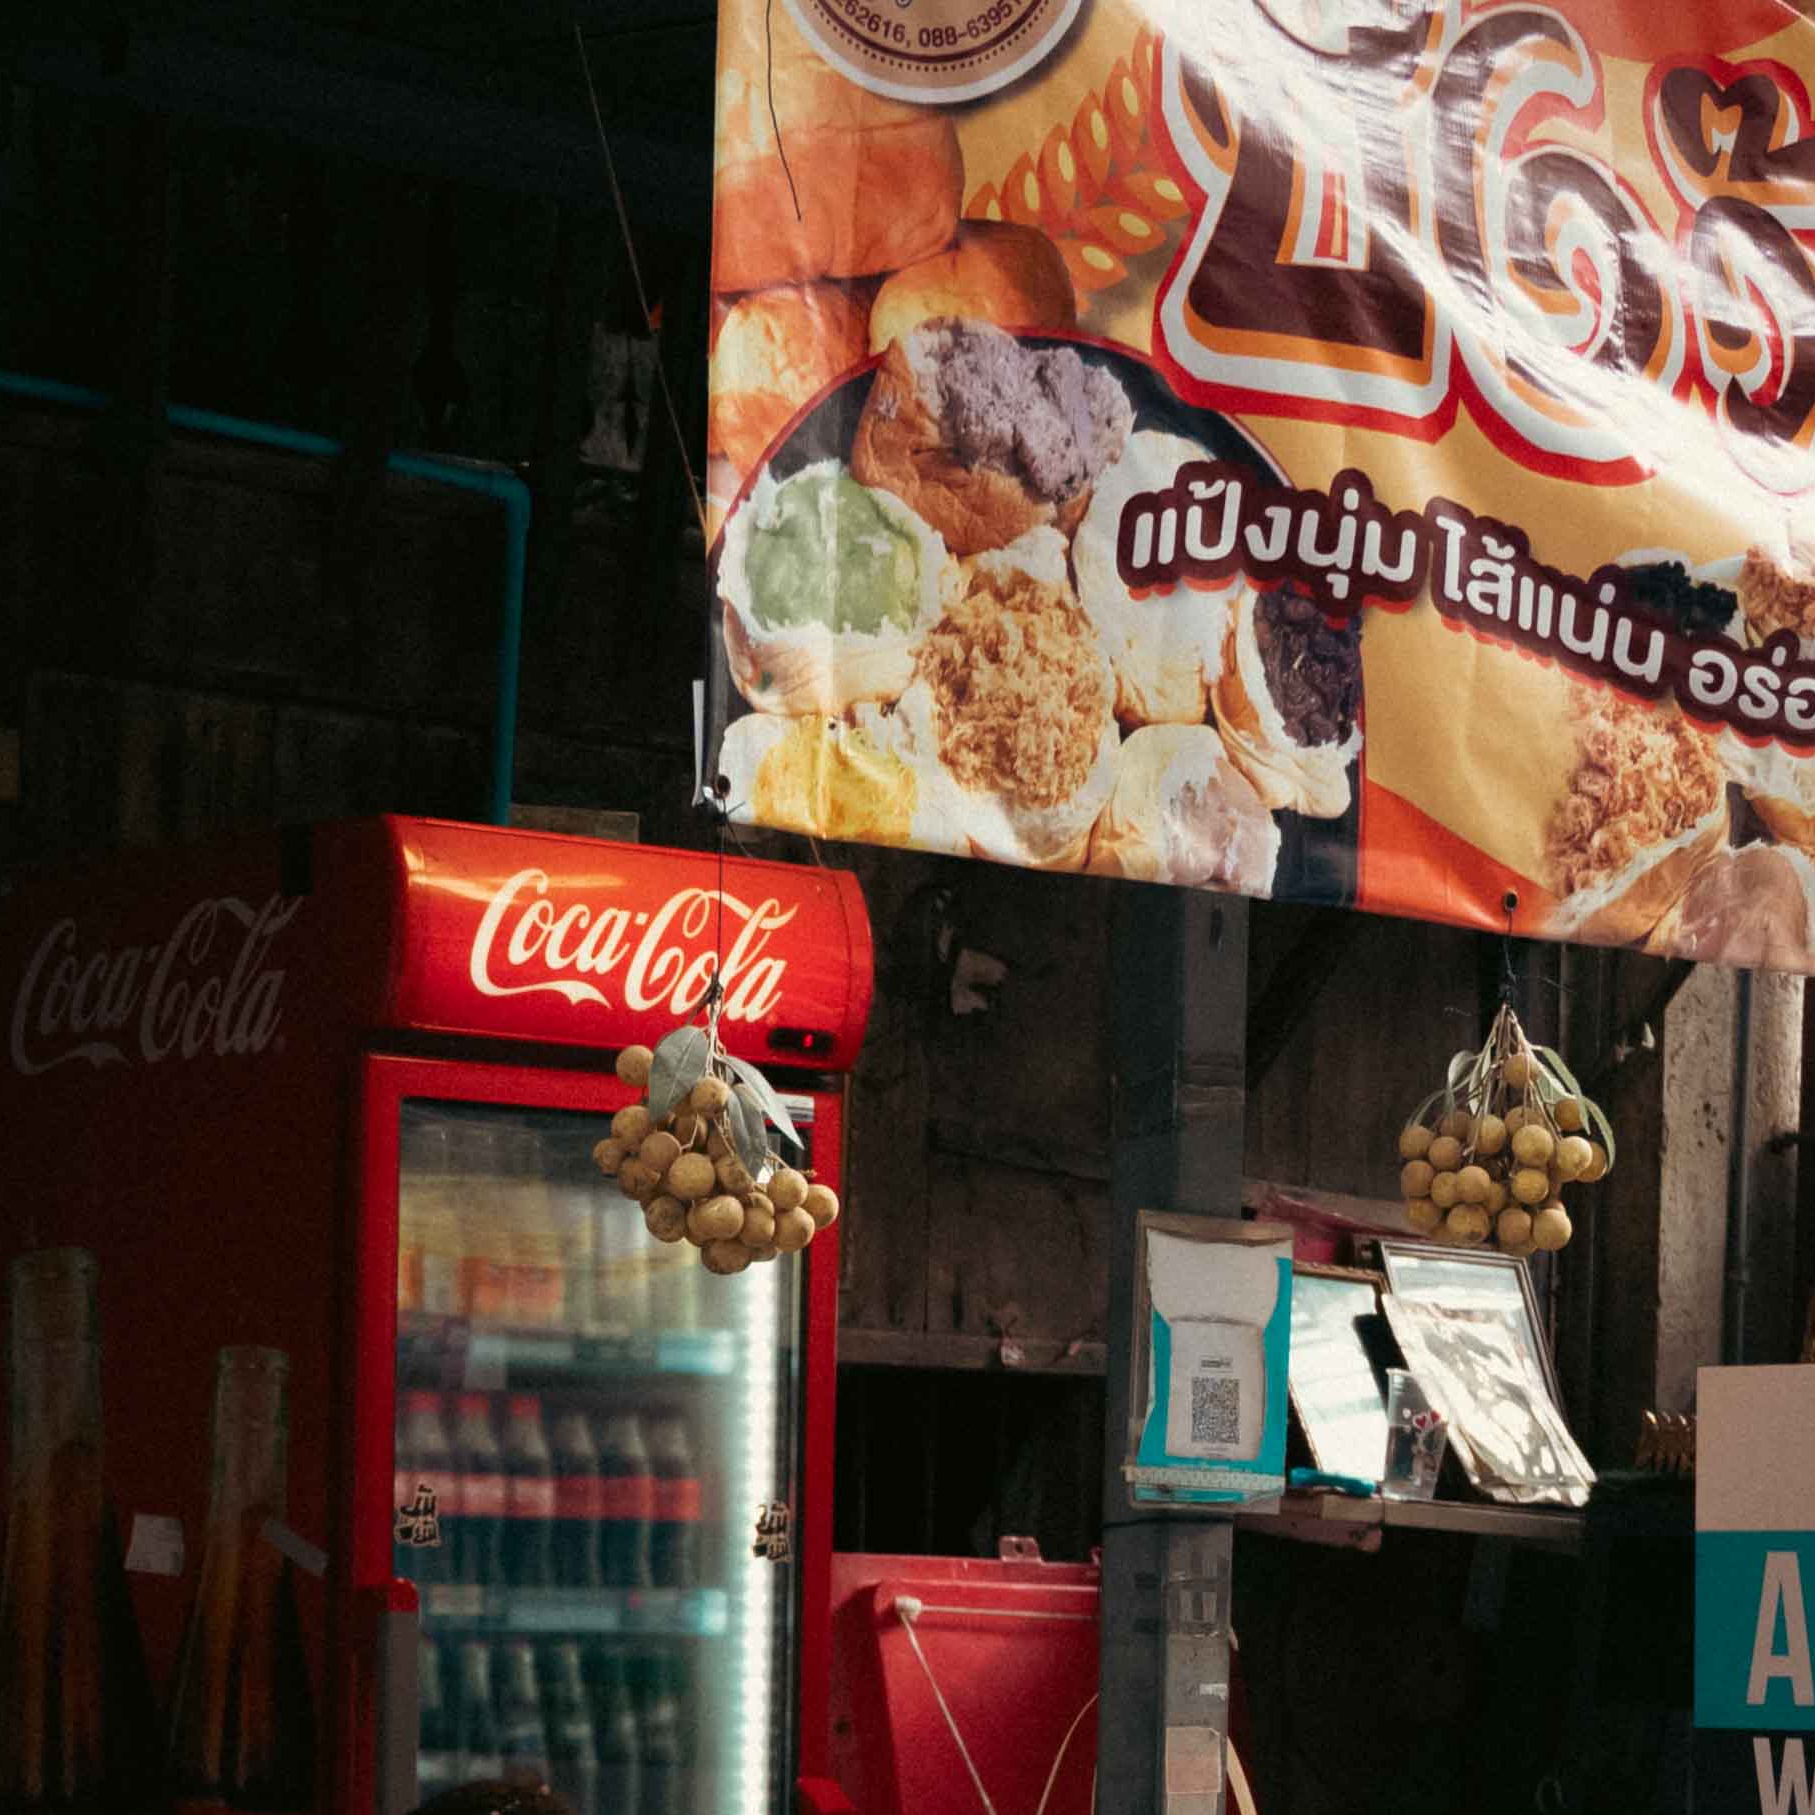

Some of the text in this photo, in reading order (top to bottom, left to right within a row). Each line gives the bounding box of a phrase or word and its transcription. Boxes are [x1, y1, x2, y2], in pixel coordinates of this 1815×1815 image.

[1131, 479, 1416, 604] แป้งนุ่ม
[1435, 513, 1664, 685] ไส้แน่น
